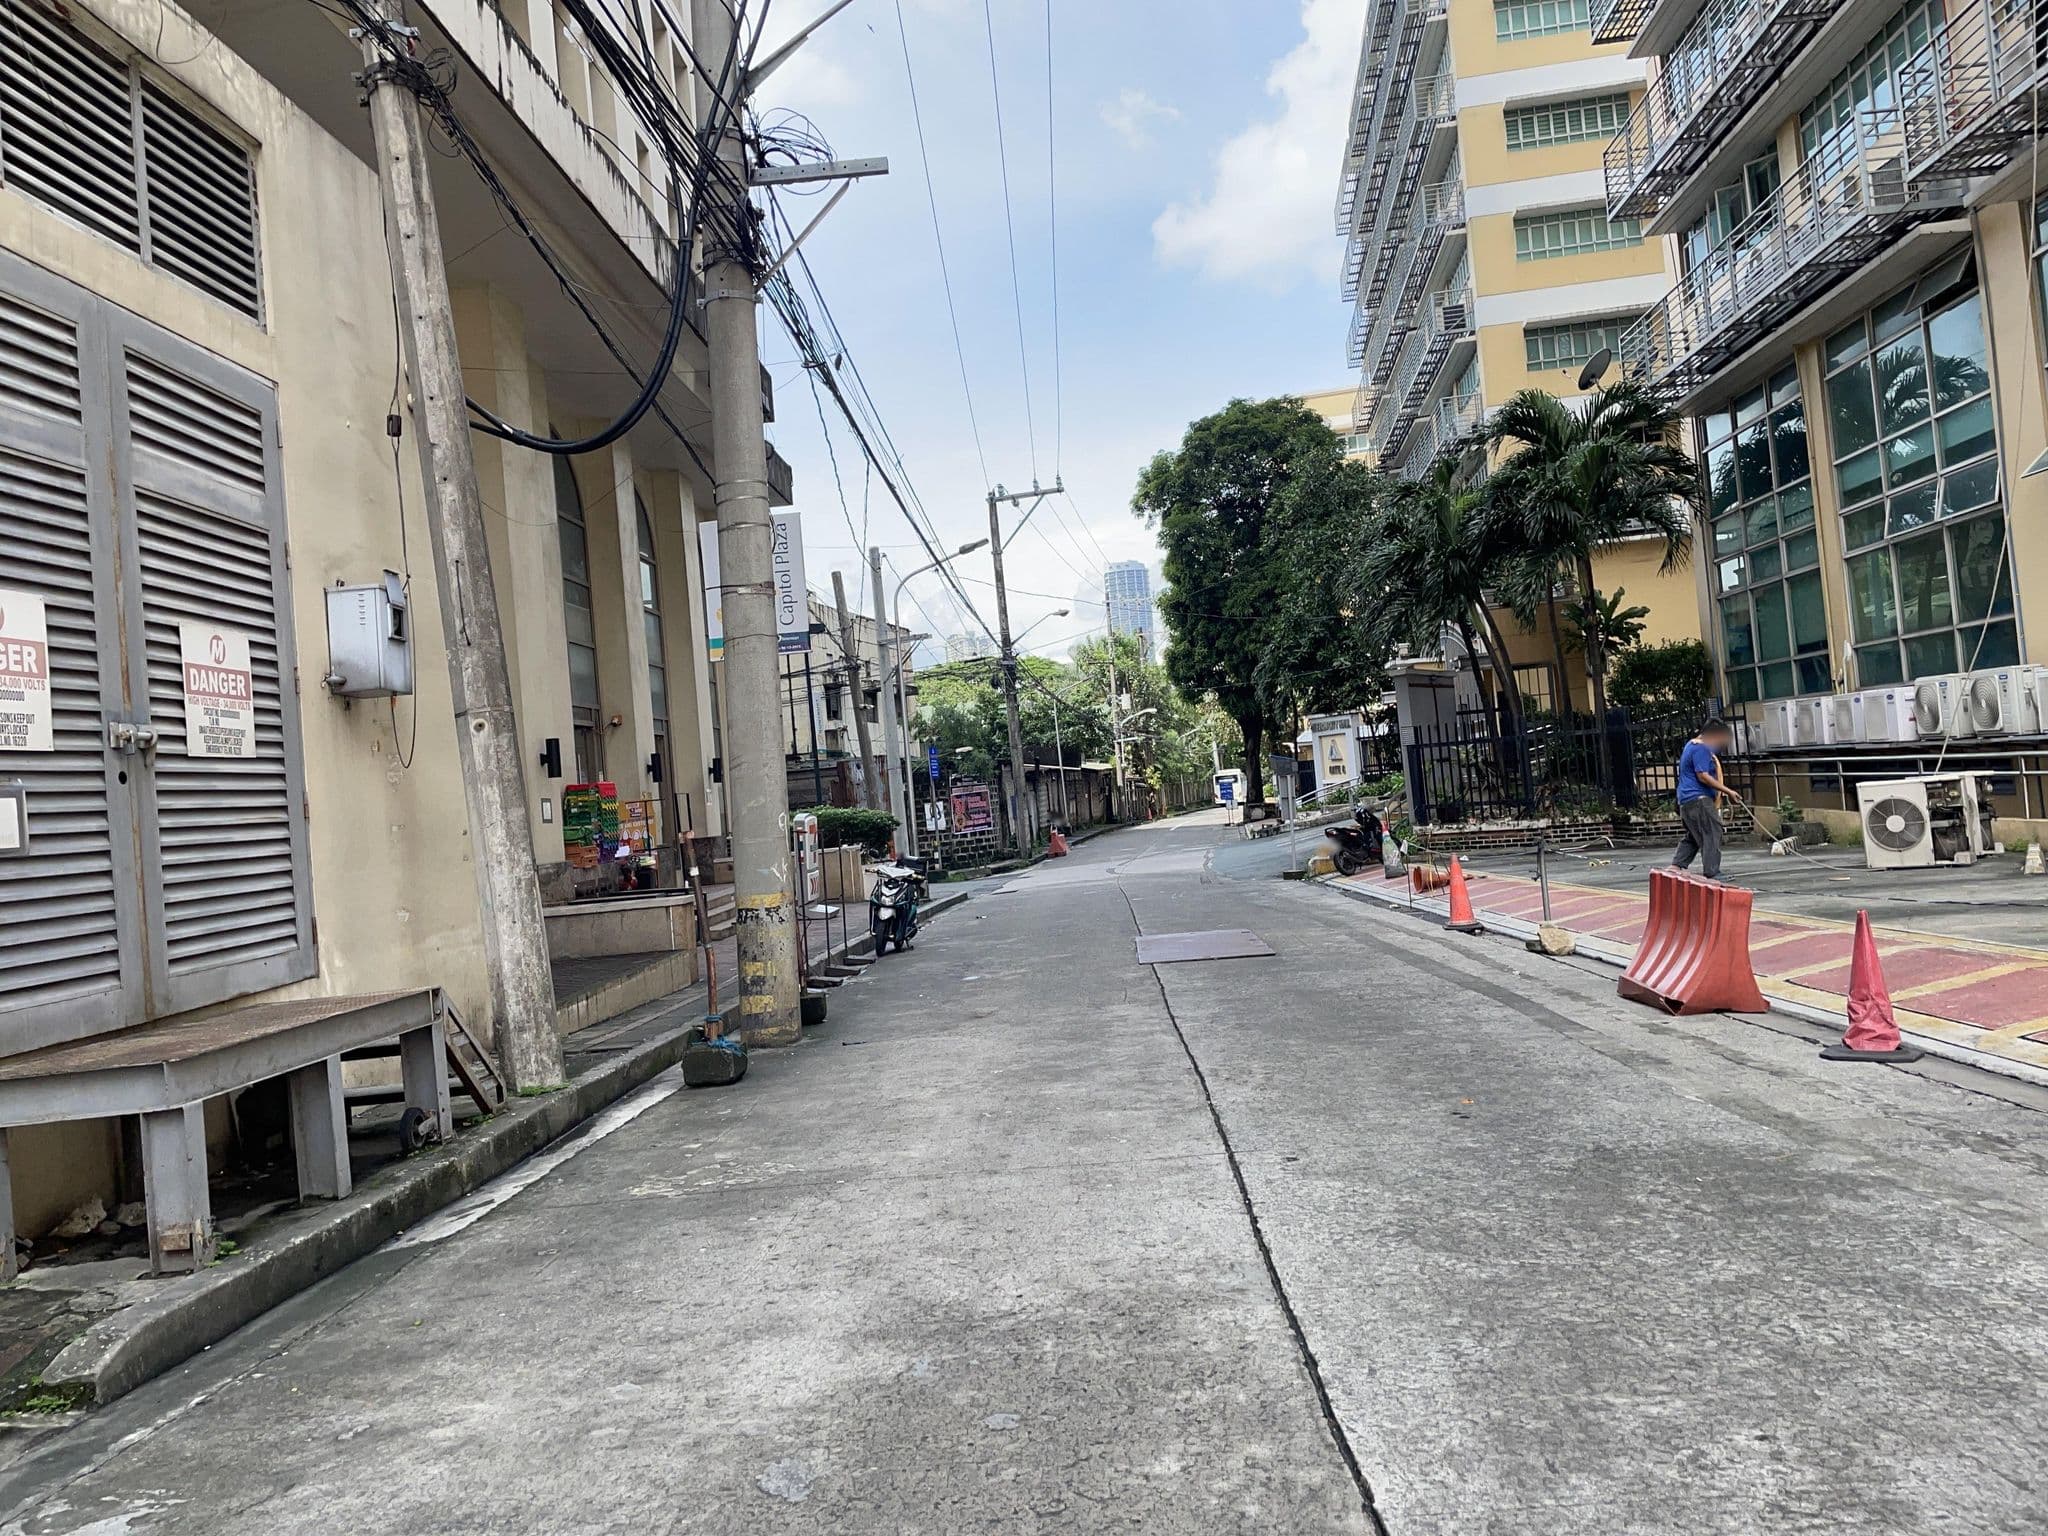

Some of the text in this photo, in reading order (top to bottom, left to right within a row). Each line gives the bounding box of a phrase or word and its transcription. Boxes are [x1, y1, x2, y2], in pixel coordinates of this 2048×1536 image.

[774, 523, 789, 565] Plaza
[774, 569, 798, 626] Capitol
[23, 679, 46, 691] VOLTS
[189, 667, 246, 697] DANGER
